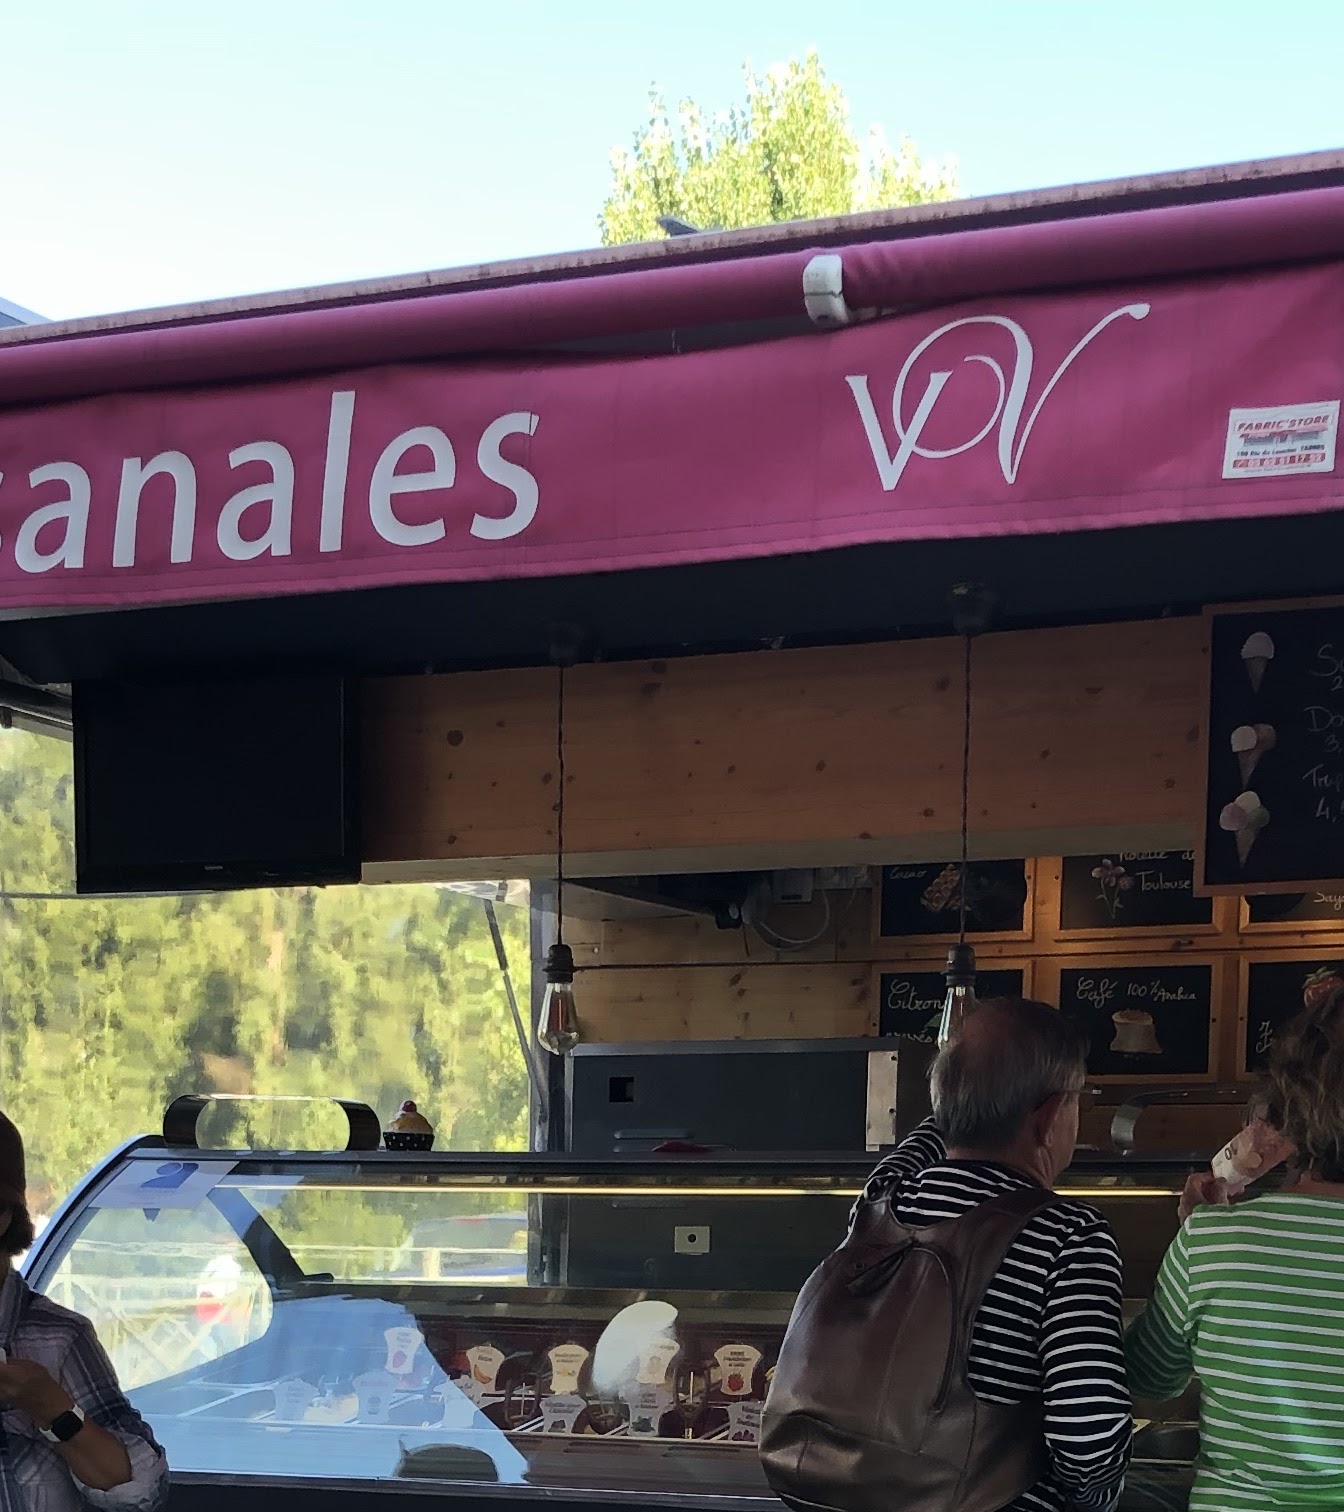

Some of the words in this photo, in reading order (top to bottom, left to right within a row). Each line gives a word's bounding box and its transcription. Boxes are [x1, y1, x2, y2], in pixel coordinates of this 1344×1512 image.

[1237, 414, 1330, 431] FABRIC'STORE
[889, 866, 929, 880] Cacao
[1136, 870, 1191, 892] Toulouse
[888, 979, 946, 1011] Citron
[1076, 976, 1120, 1009] Café
